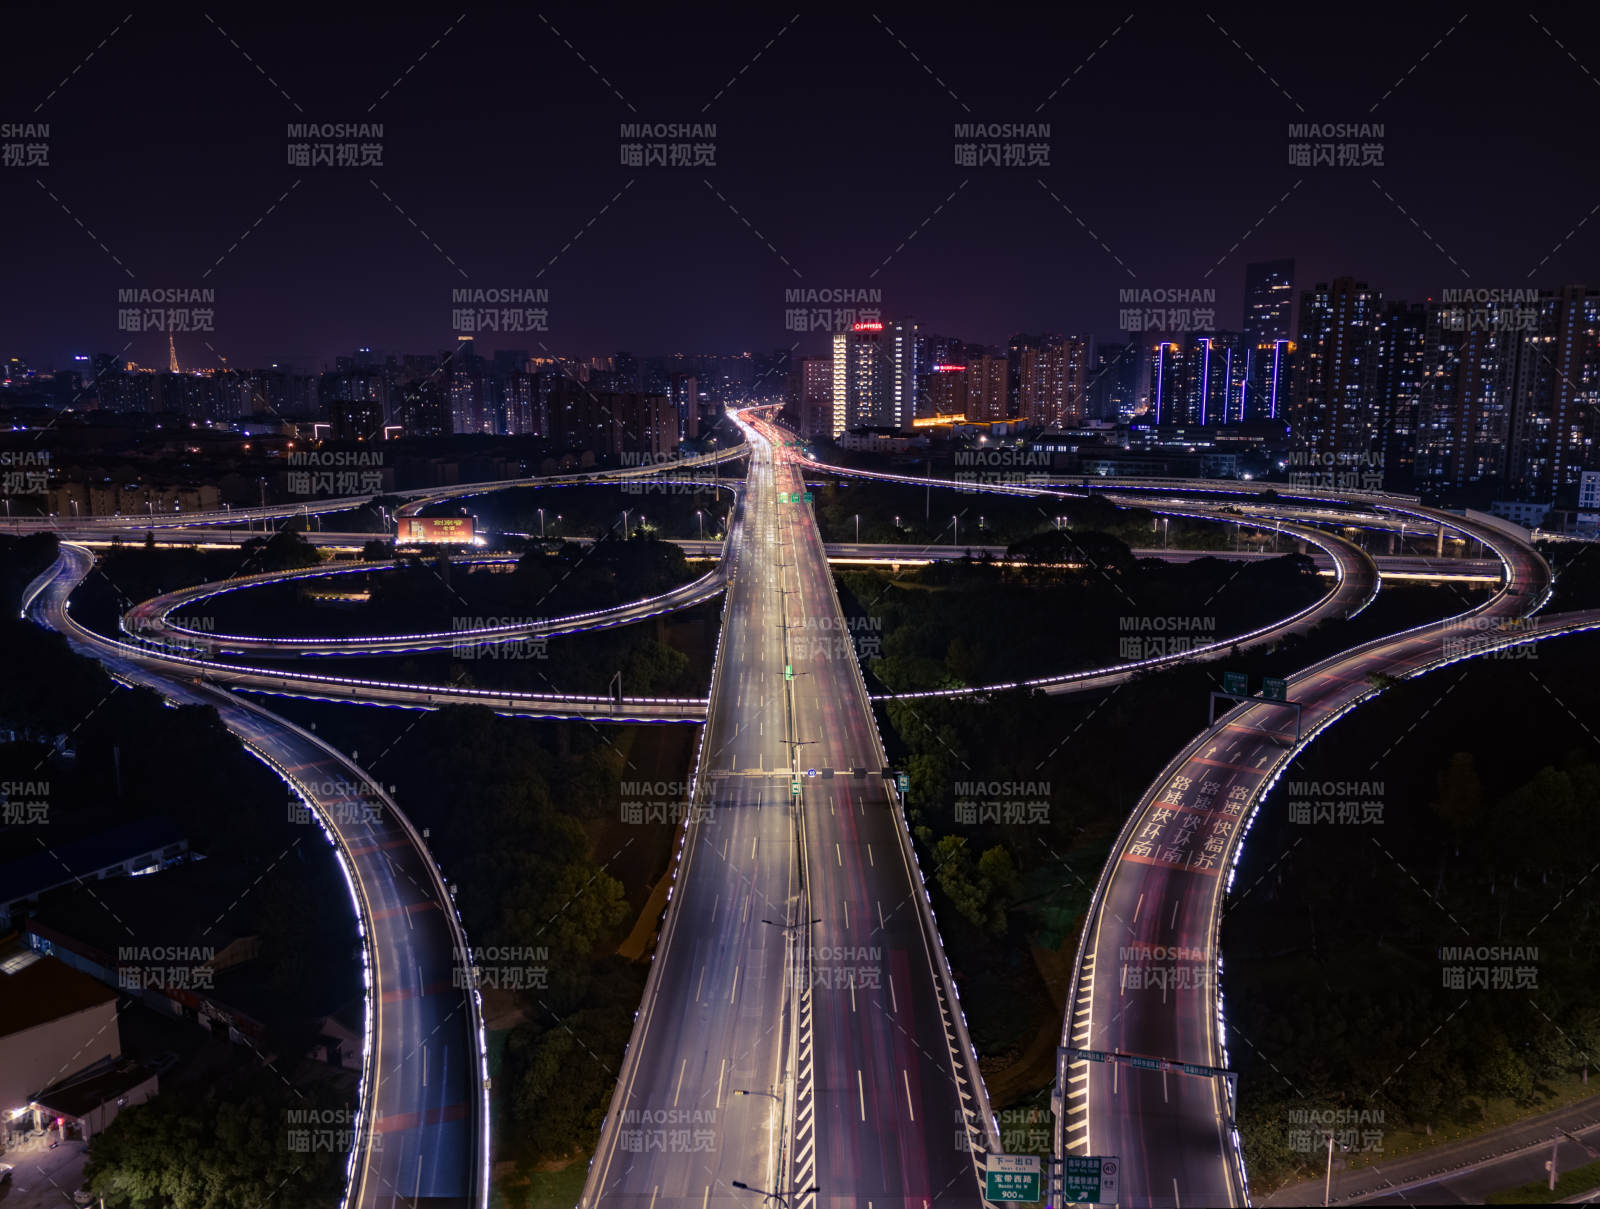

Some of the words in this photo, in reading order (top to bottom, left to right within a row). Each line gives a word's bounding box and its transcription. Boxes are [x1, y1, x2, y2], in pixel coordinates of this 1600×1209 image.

[997, 1157, 1033, 1166] 下一出口
[1001, 1191, 1018, 1199] 900
